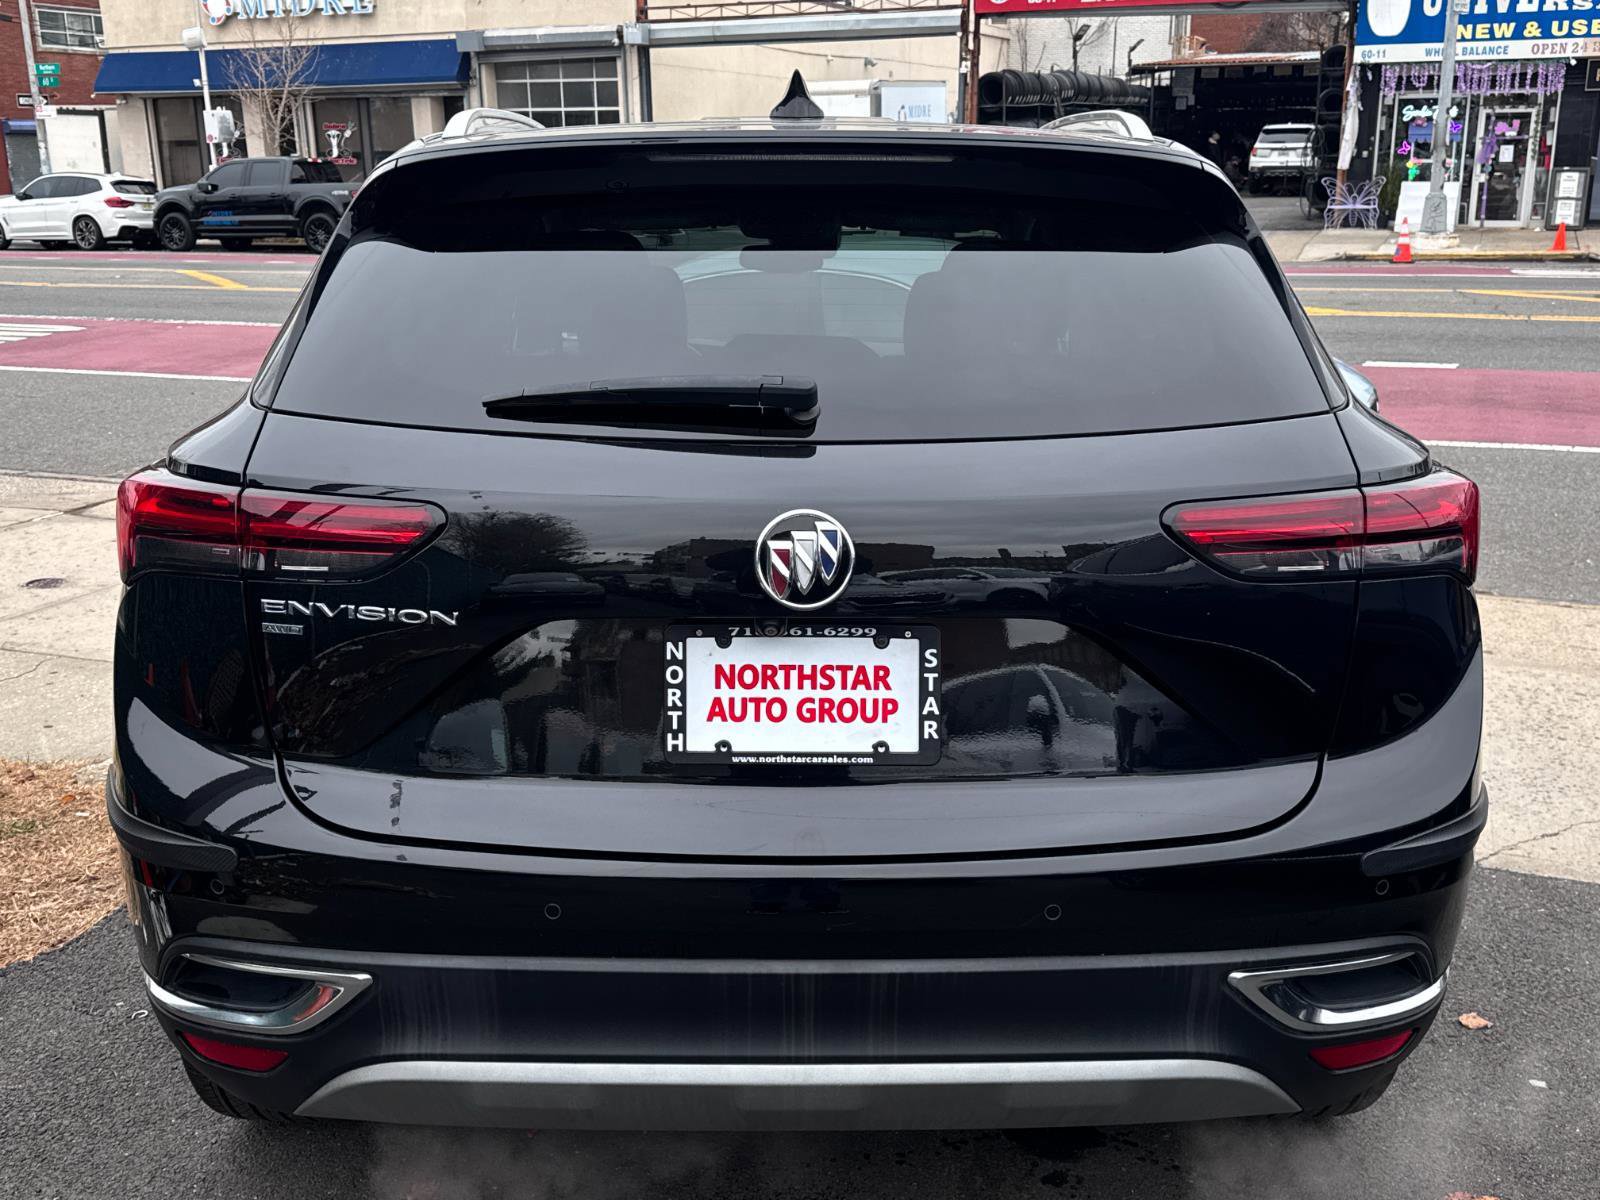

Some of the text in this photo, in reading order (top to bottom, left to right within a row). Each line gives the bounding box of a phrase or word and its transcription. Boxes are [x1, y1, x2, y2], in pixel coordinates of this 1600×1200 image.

[1456, 22, 1516, 39] NEW
[1523, 21, 1542, 37] &
[1361, 49, 1387, 60] 60-11
[1462, 45, 1510, 57] BALANCE
[1531, 42, 1569, 56] OPEN
[260, 598, 459, 626] ENVISION
[714, 663, 893, 691] NORTHSTAR
[665, 641, 684, 752] NORTH
[922, 648, 940, 740] STAR
[706, 696, 899, 724] AUTO GROUP
[731, 754, 874, 764] www.northstarcarsales.com
